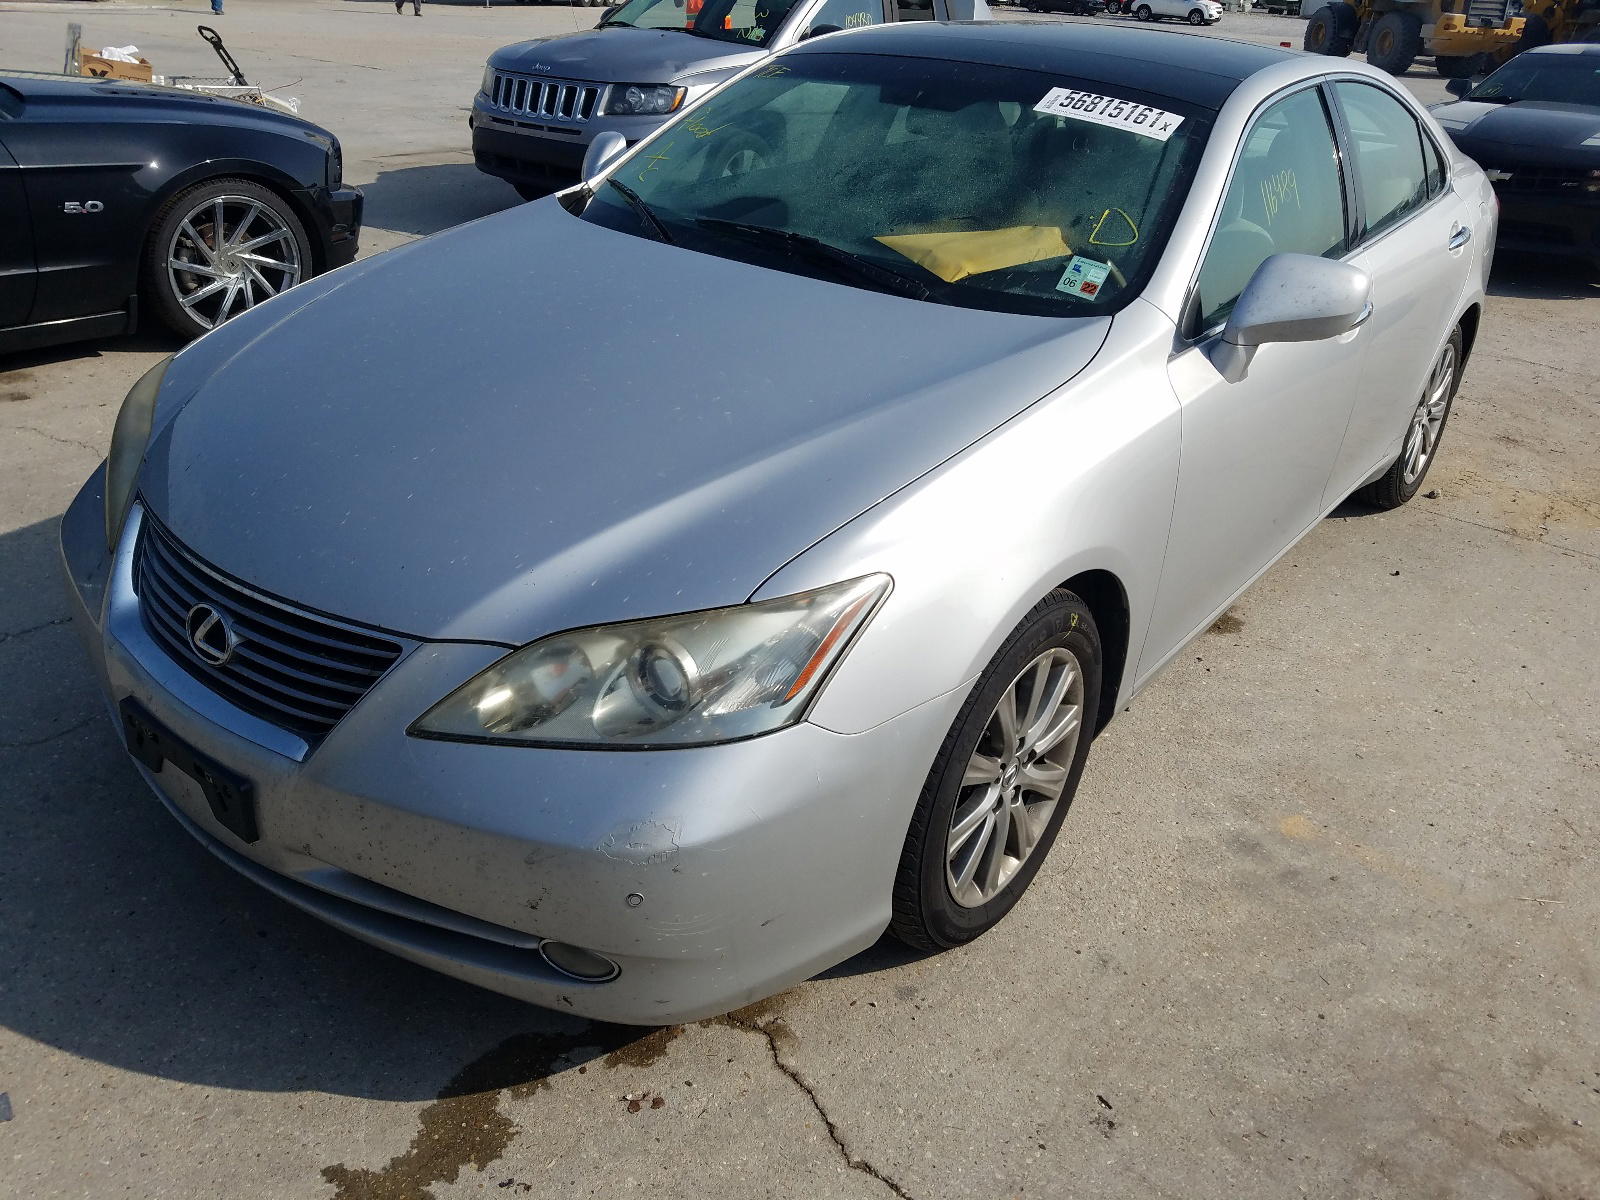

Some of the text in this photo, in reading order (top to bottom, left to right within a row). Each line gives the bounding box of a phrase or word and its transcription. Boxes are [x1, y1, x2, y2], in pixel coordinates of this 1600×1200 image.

[1059, 91, 1165, 128] 56815161
[64, 200, 104, 214] 5.0
[1062, 277, 1099, 294] 06 22
